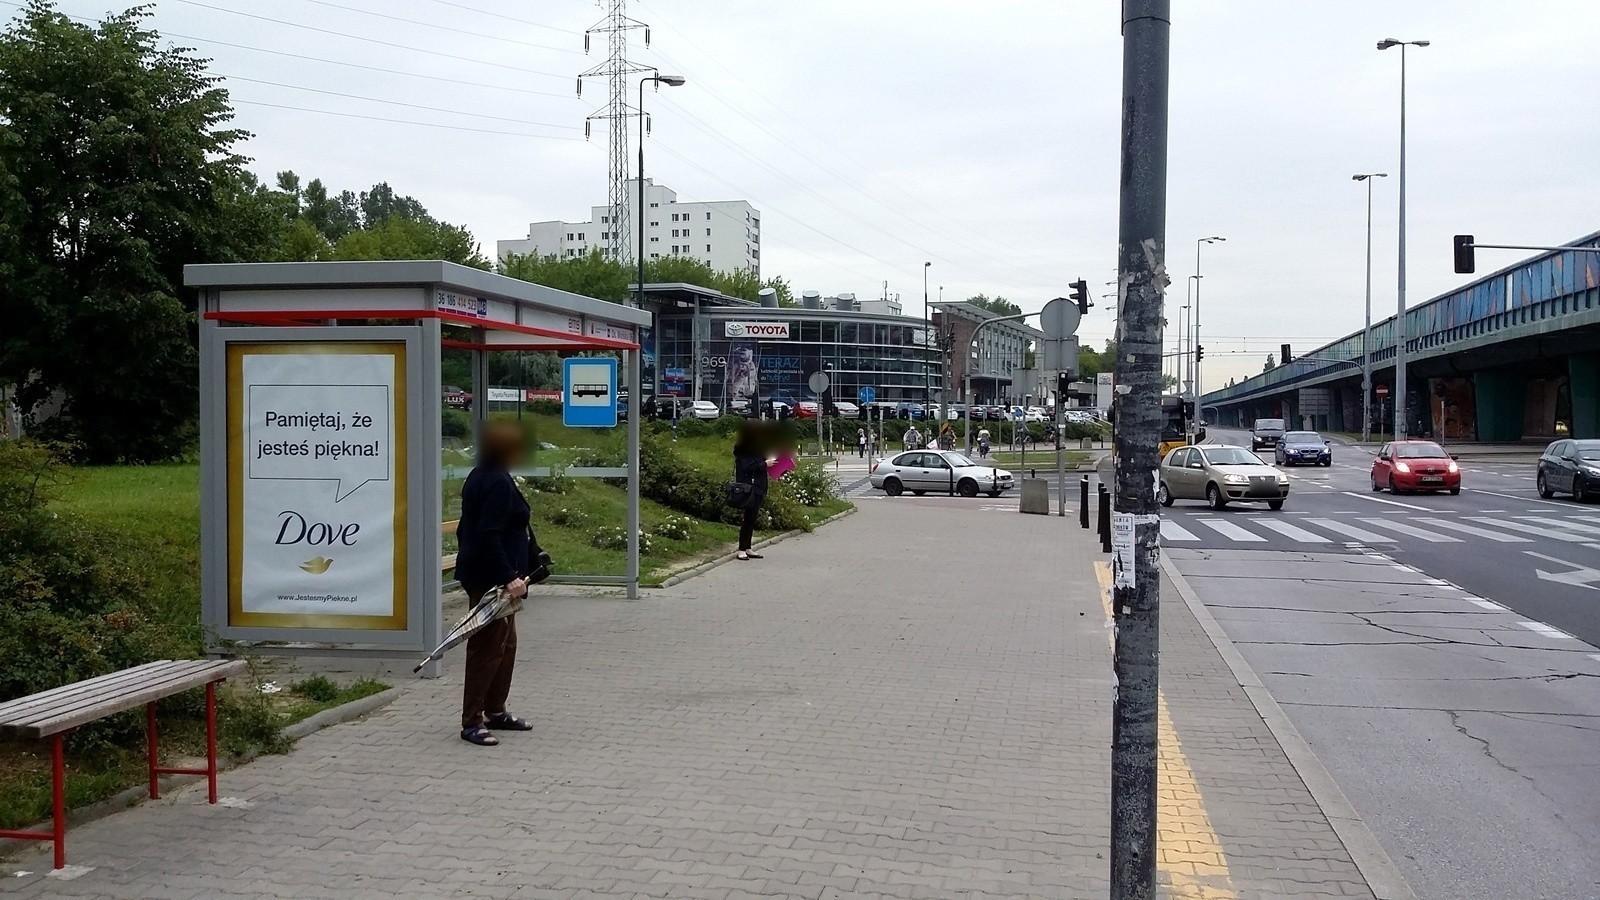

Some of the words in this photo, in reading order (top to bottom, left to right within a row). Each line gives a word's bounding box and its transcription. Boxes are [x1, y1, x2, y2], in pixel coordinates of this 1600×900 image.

[745, 325, 788, 335] TOYOTA
[700, 356, 727, 368] 969
[760, 357, 800, 369] TERAZ
[265, 411, 346, 432] Pamiętaj,
[351, 411, 373, 428] że
[256, 439, 309, 460] jesteś
[314, 440, 379, 461] piękna!
[274, 510, 361, 546] Dove
